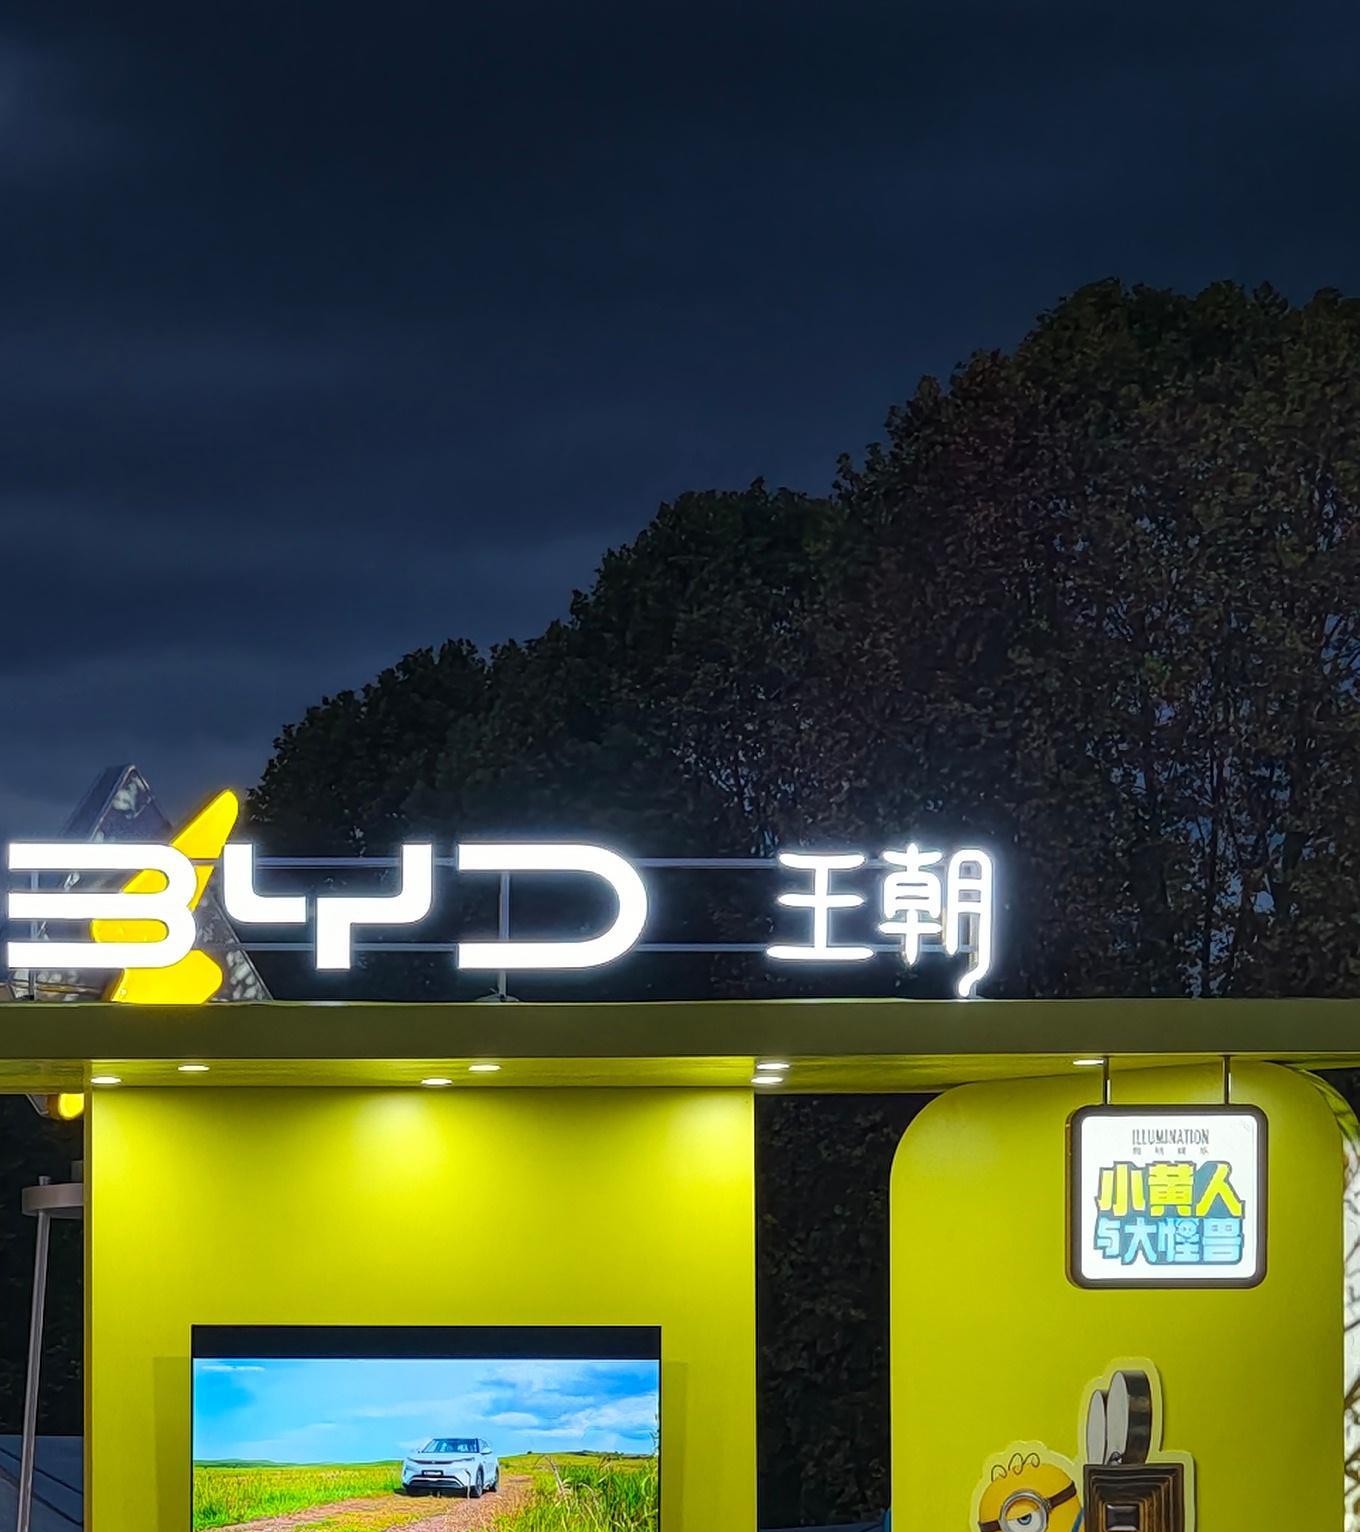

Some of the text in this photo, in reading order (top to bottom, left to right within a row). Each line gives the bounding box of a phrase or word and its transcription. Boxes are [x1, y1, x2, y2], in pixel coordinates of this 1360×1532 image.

[8, 842, 993, 997] BYD 王朝
[1132, 1129, 1209, 1145] ILLUMINATION
[1097, 1162, 1244, 1217] 小黄人
[1095, 1217, 1243, 1264] 与大怪兽
